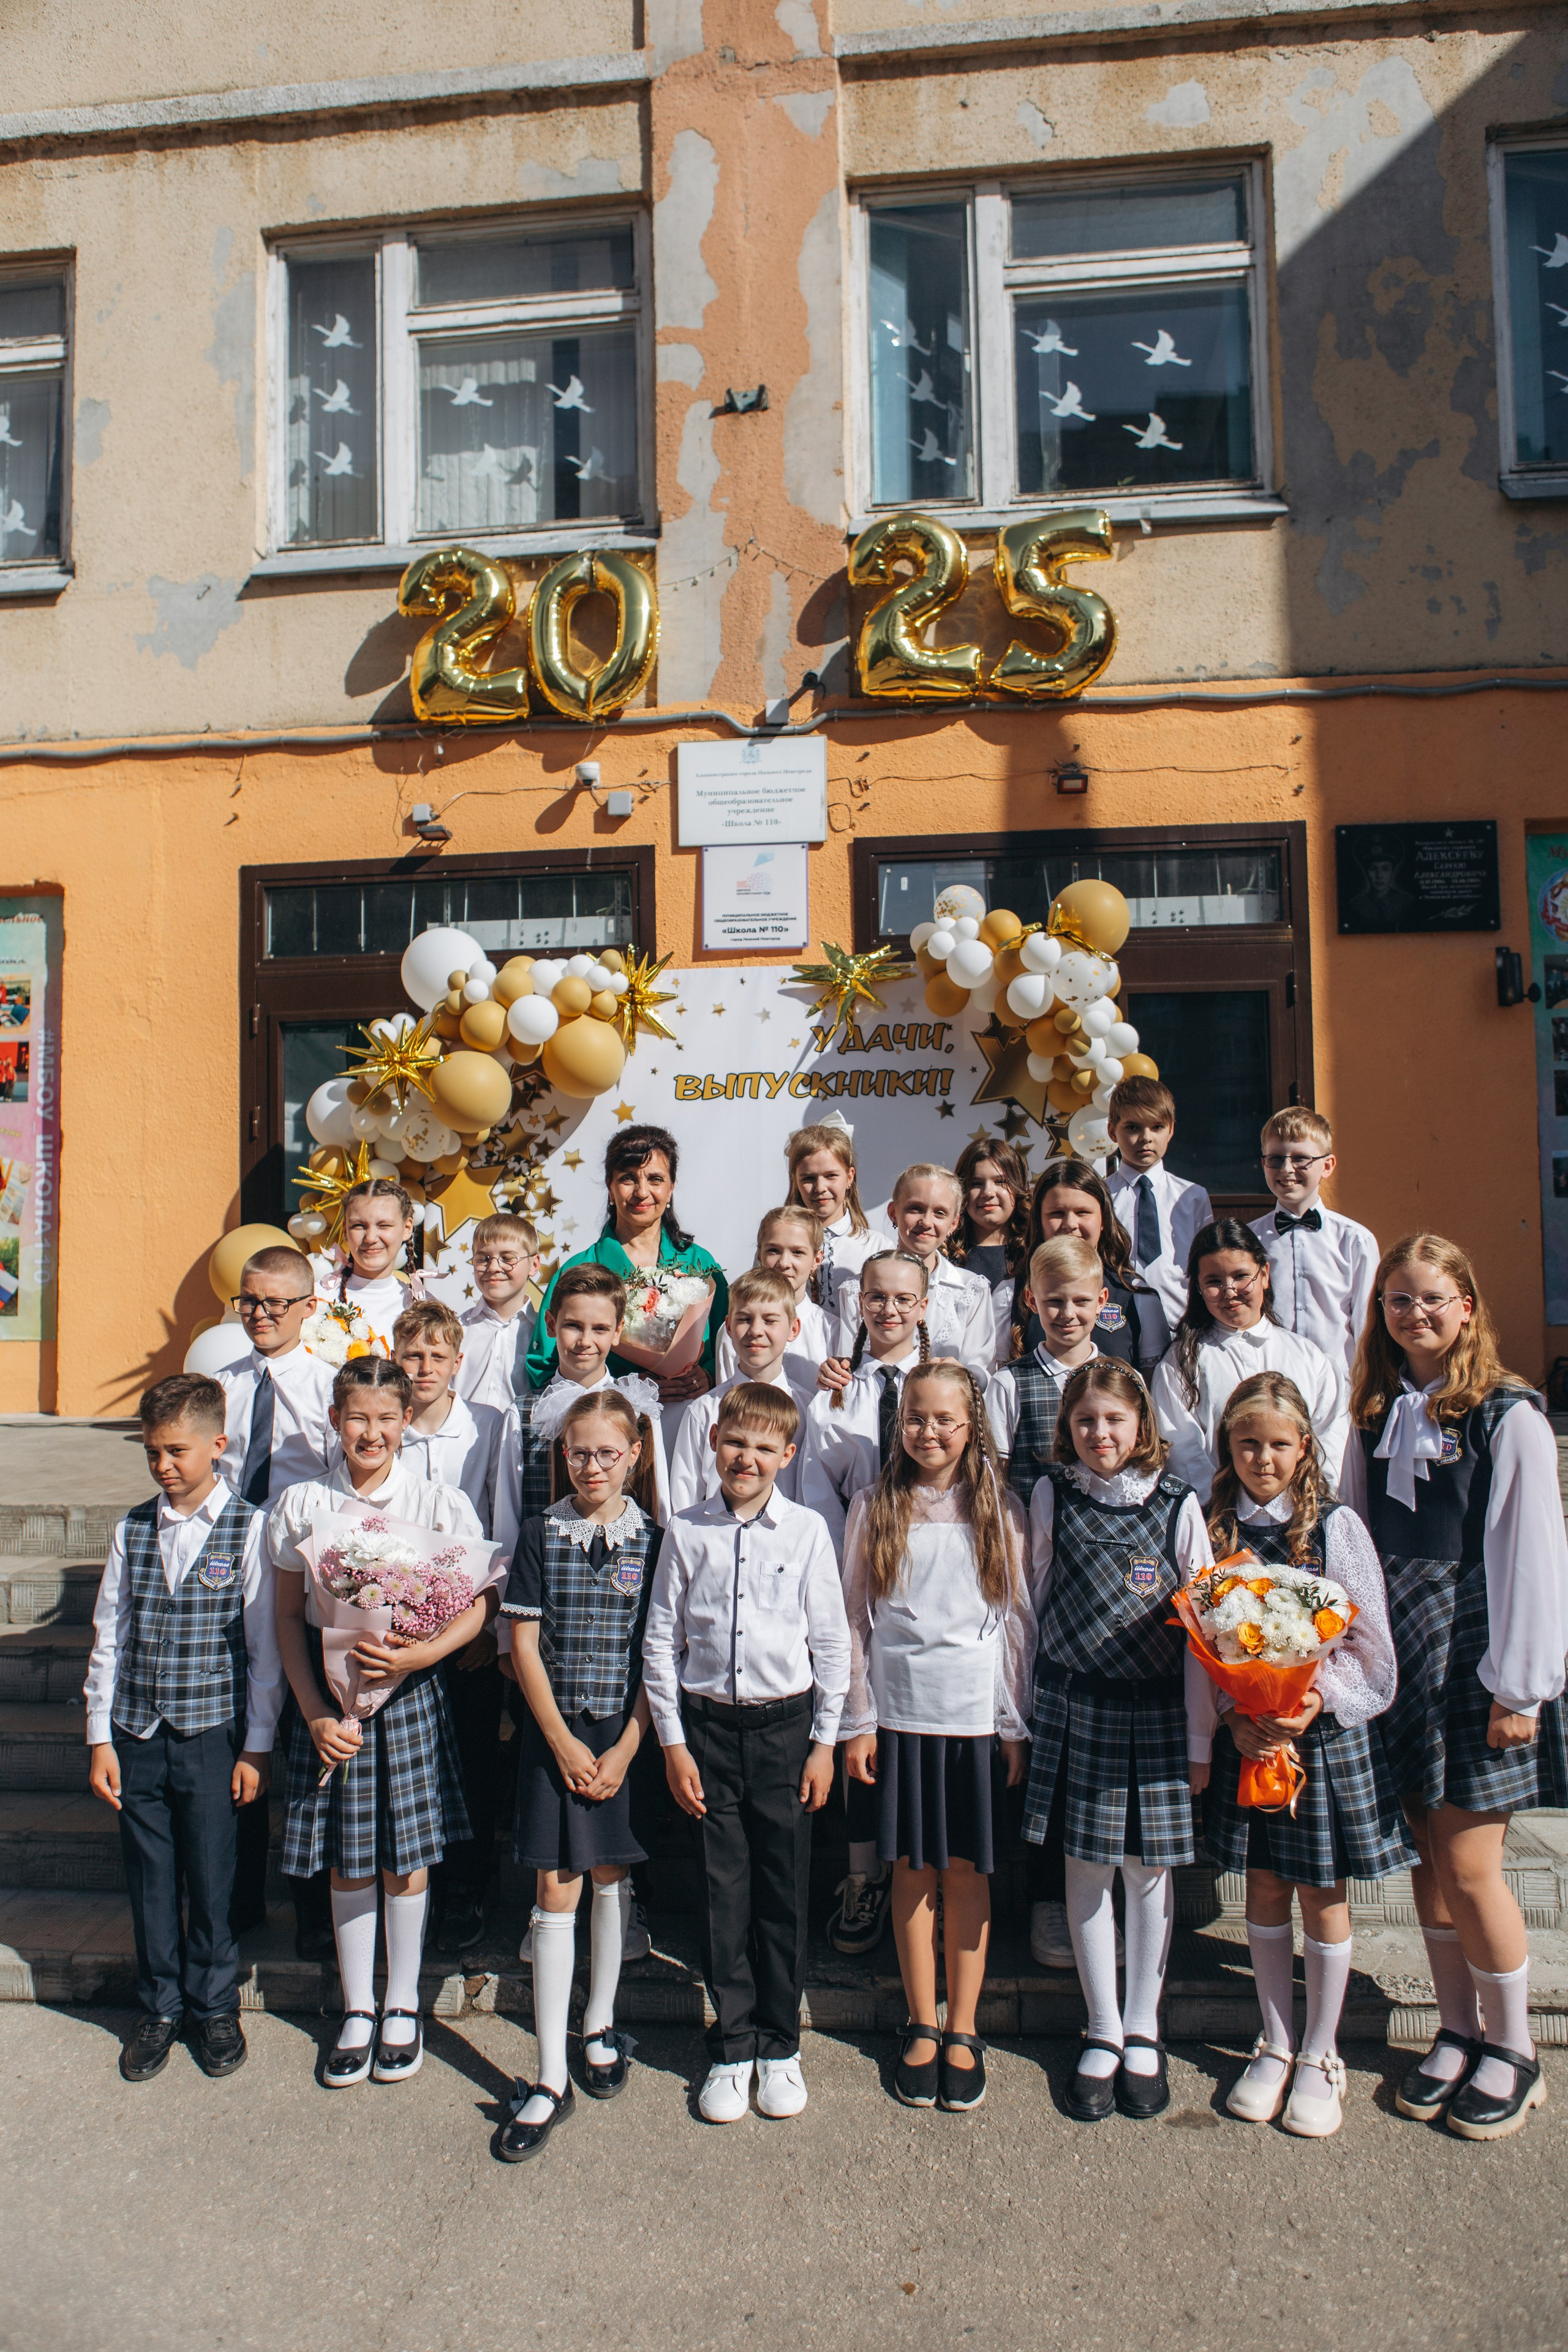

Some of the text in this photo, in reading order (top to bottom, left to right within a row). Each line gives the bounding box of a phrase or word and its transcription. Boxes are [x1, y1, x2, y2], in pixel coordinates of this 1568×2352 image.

[696, 786, 806, 797] Муниципальное бюджетное
[708, 797, 794, 806] общеобразовательное
[727, 807, 775, 816] учреждение
[811, 1022, 955, 1055] УДАЧИ,
[673, 1068, 955, 1101] ВЫПУСКНИКИ!
[209, 1567, 227, 1575] 110
[1135, 1572, 1152, 1581] 110
